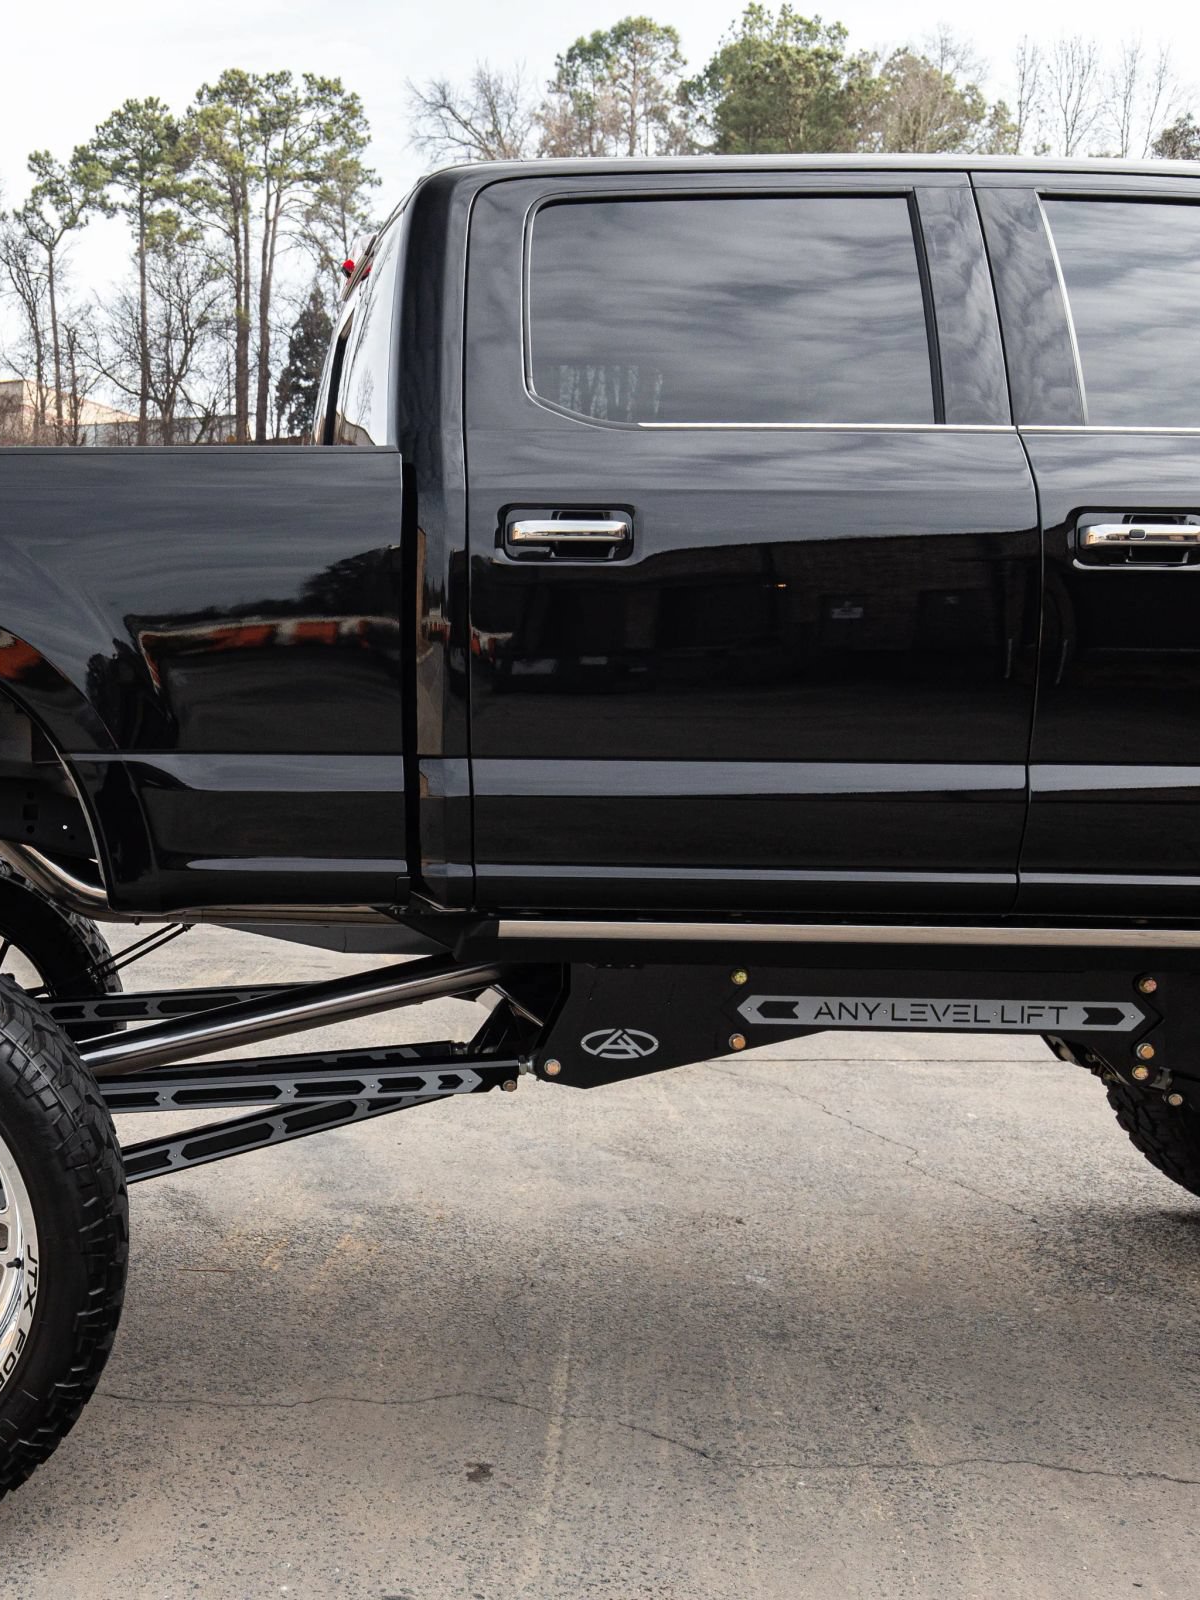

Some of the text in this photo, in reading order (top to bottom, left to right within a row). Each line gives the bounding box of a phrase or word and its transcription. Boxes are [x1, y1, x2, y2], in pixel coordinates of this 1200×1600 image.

[813, 1001, 1068, 1025] ANY LEVEL LIFT
[23, 1244, 39, 1317] JTX
